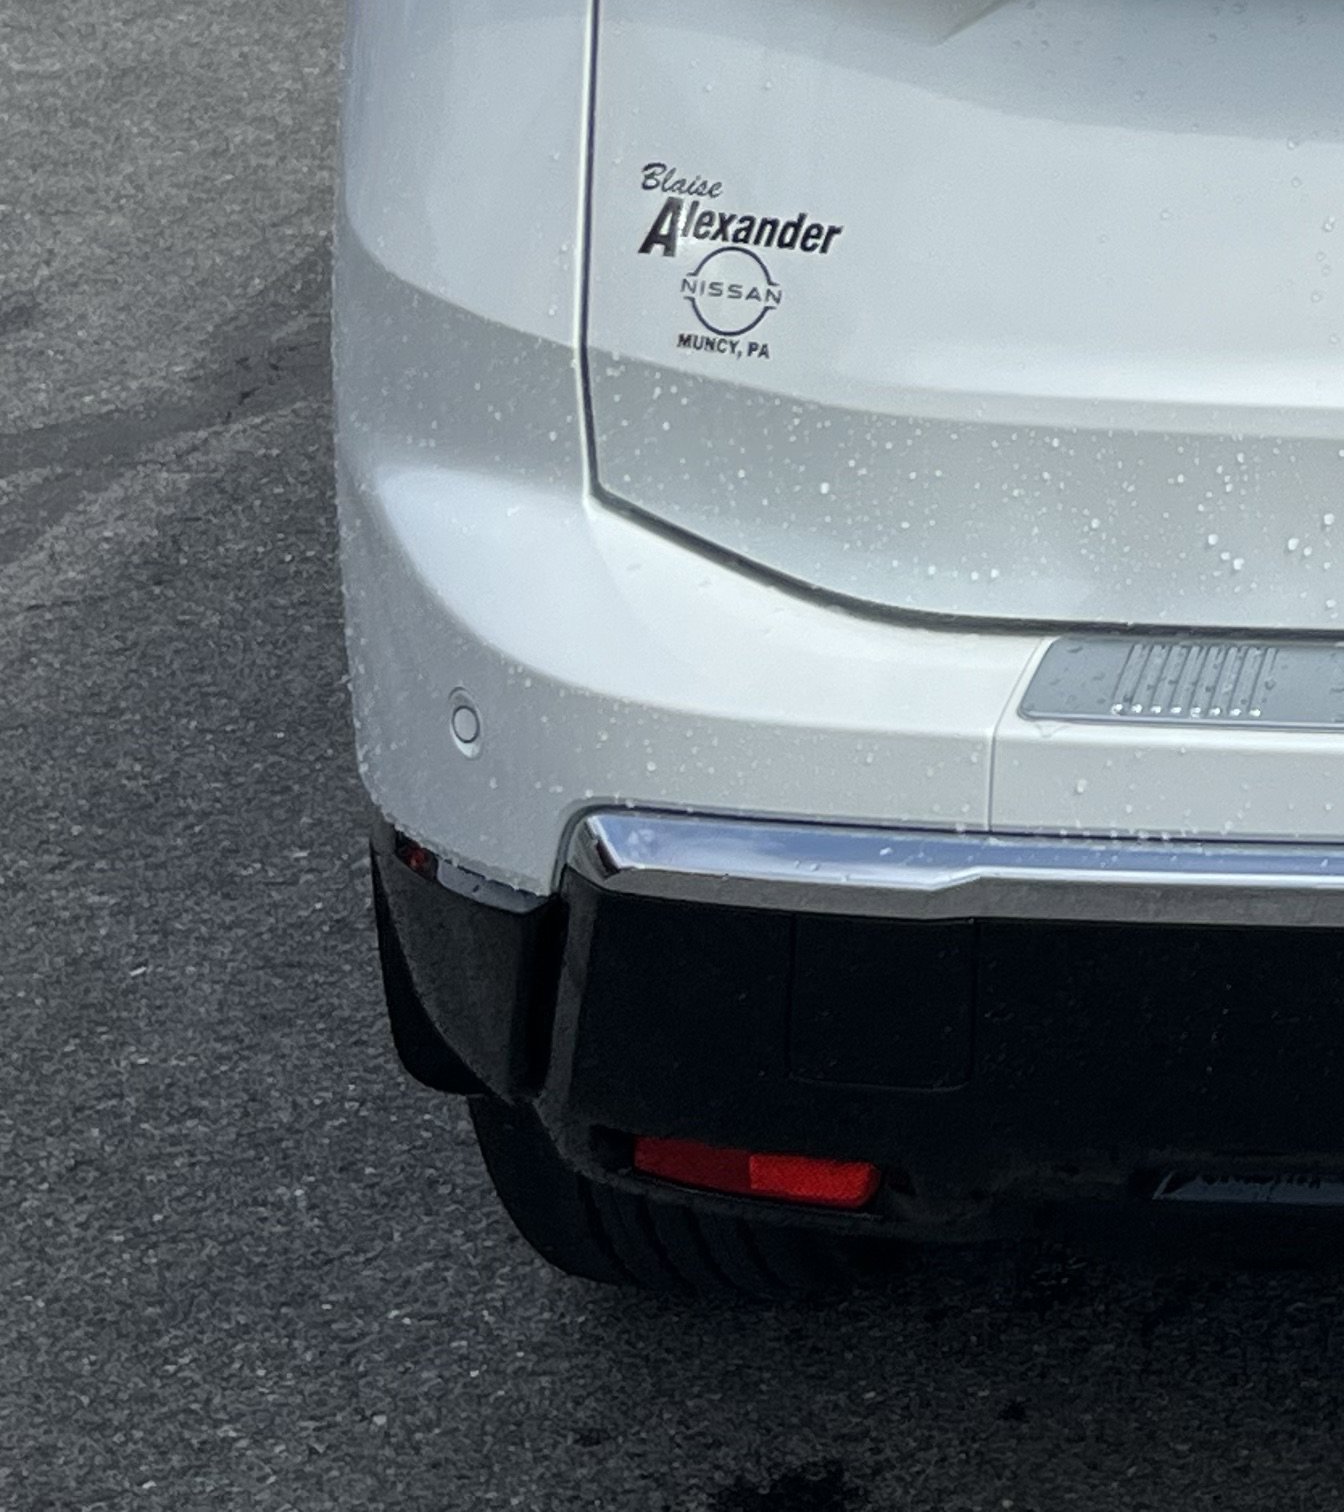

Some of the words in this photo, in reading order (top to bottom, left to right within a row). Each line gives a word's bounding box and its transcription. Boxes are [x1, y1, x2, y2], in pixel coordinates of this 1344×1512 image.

[640, 161, 724, 199] Blaise
[637, 195, 844, 258] Alexander
[680, 277, 782, 305] NISSAN
[676, 333, 743, 360] MUNCY,
[746, 341, 770, 359] PA
